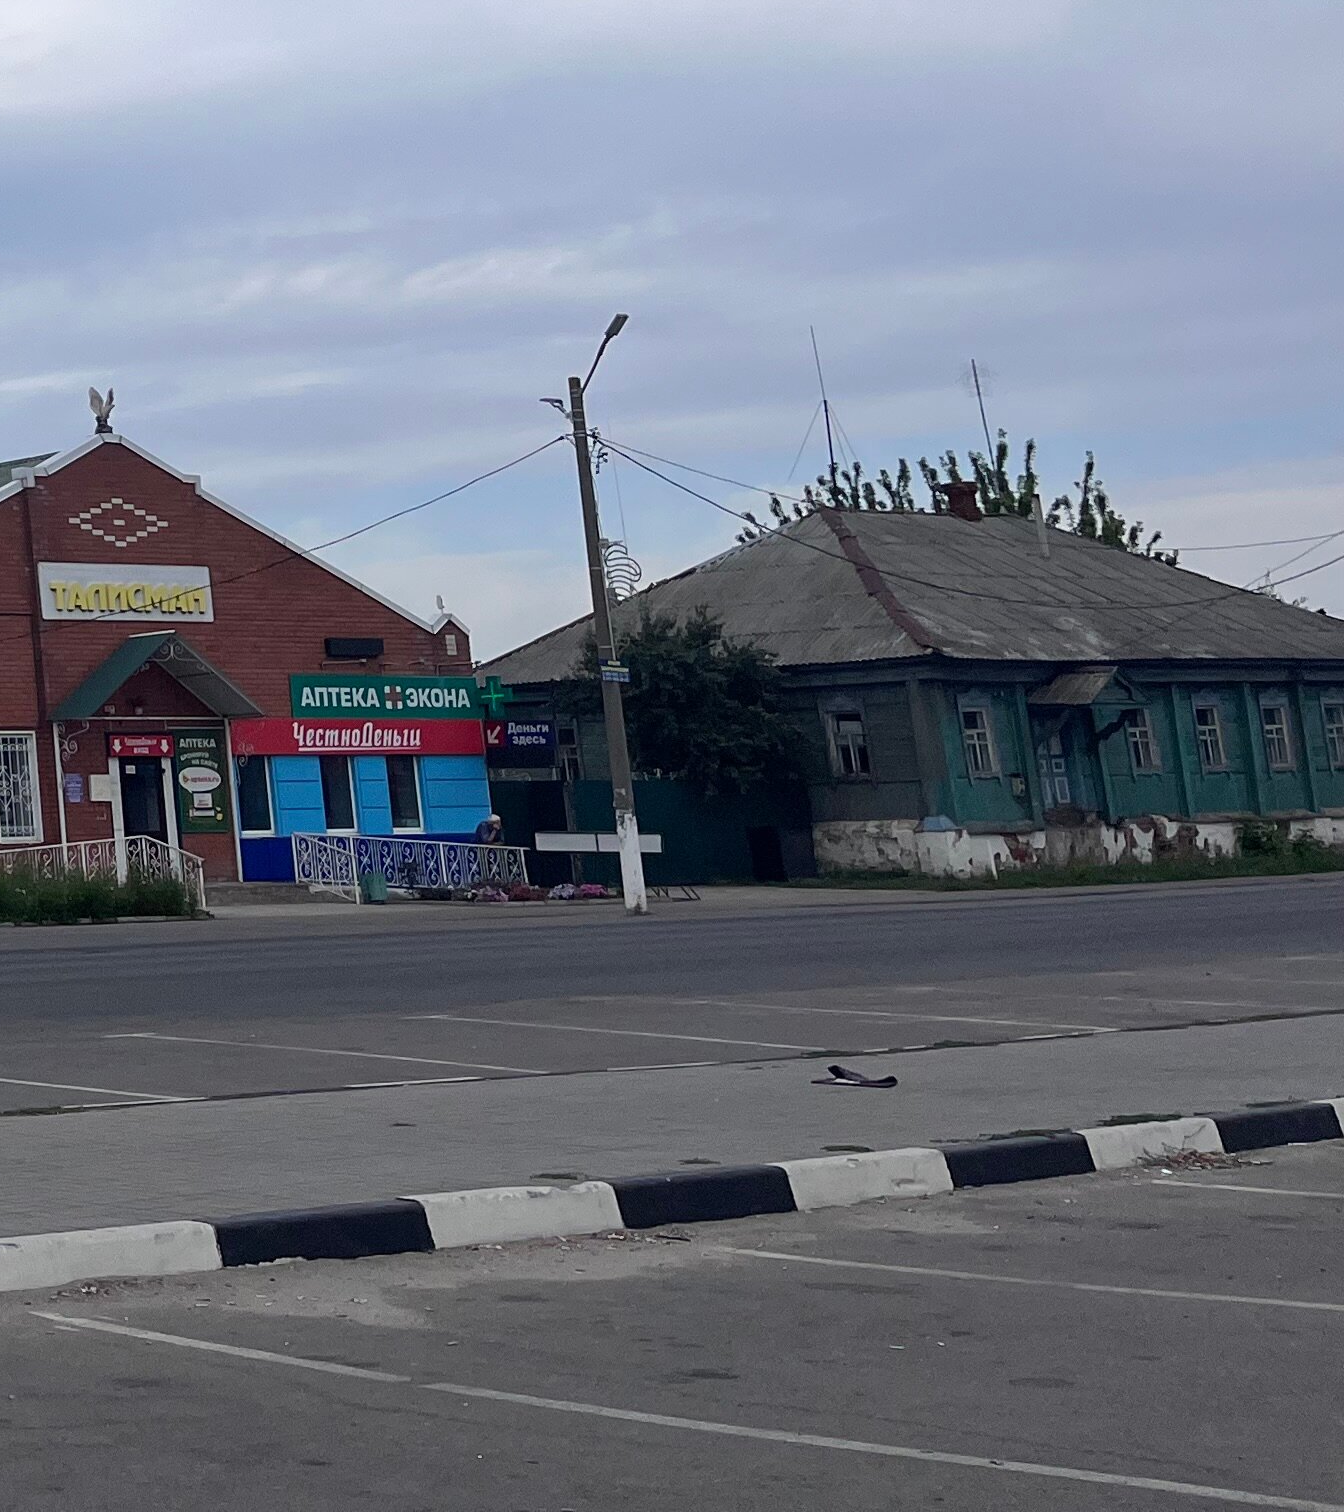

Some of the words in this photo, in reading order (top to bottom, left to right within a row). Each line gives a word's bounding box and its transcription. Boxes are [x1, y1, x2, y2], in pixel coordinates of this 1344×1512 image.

[49, 580, 207, 614] ТАЛИСМАН
[301, 686, 380, 707] АПТЕКА
[406, 688, 471, 708] ЭКОНА
[292, 722, 422, 748] ЧестноДеньги
[507, 722, 549, 735] Деньги
[179, 738, 217, 748] АПТЕКА
[512, 734, 546, 746] здесь
